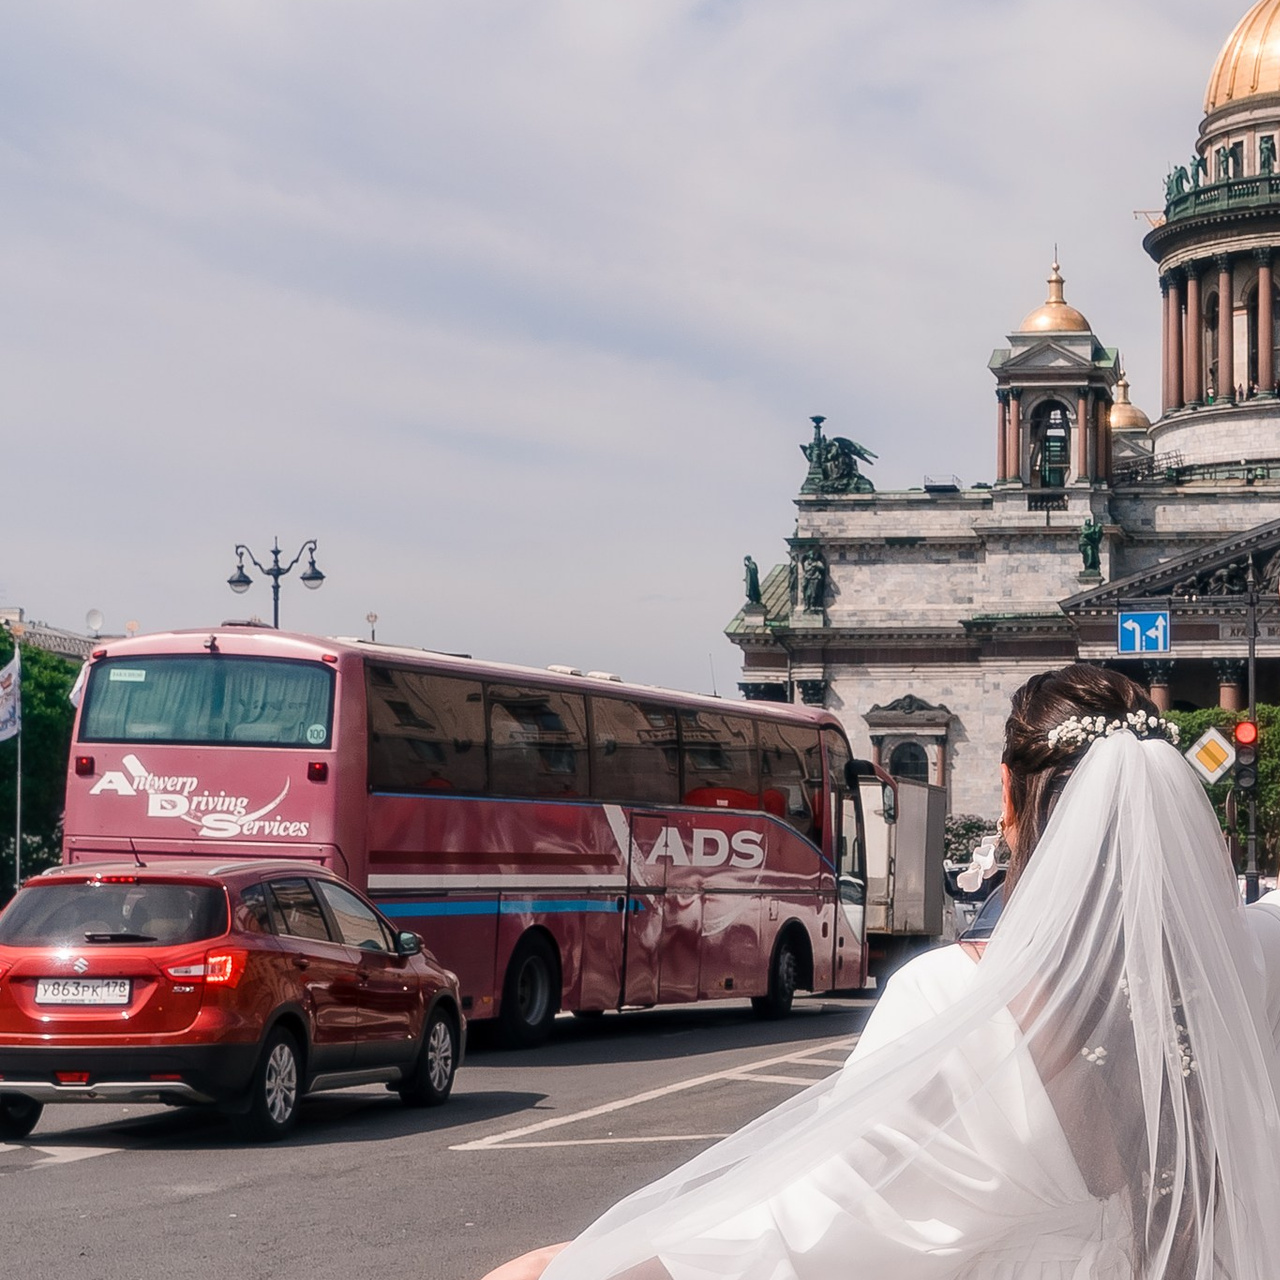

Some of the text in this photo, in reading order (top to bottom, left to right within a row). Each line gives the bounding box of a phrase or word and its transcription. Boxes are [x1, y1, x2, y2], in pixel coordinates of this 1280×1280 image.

[309, 728, 325, 740] 100
[198, 814, 310, 838] Services
[645, 826, 764, 869] ADS
[104, 981, 127, 994] 178
